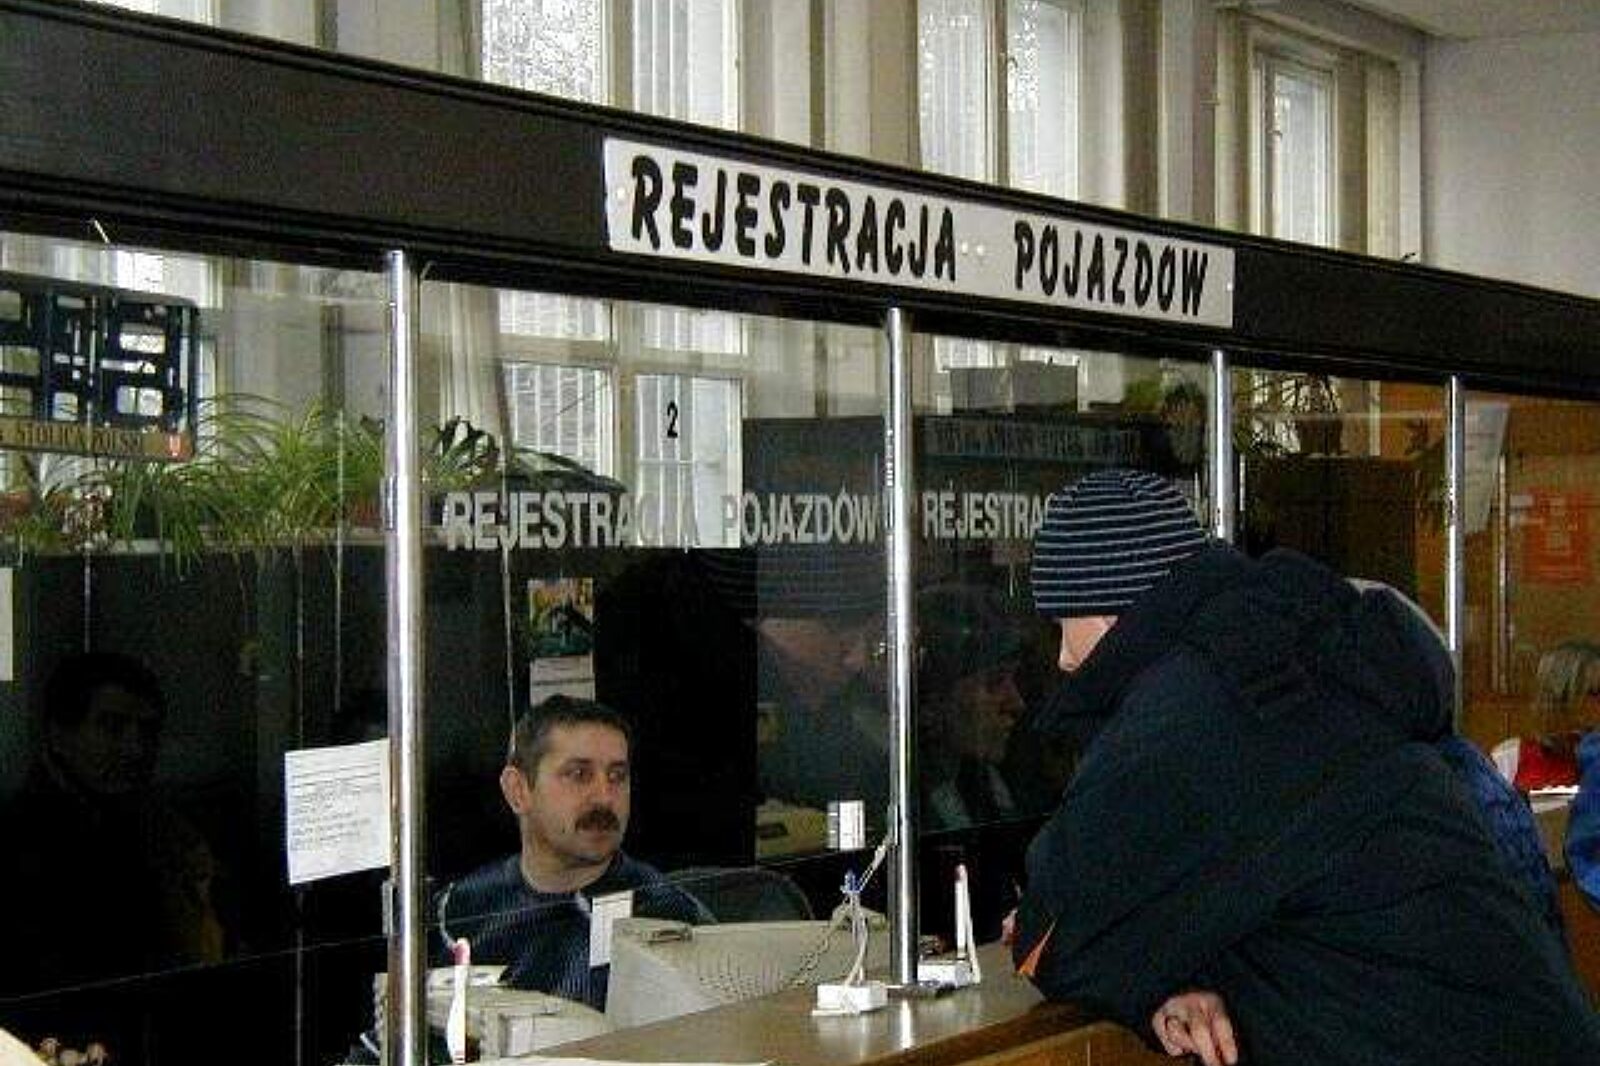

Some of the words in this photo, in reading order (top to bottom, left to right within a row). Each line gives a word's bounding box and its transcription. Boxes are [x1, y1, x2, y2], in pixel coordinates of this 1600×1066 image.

[631, 155, 956, 282] REJESTRACJA
[667, 401, 678, 438] 2
[447, 491, 700, 551] REJESTRACA
[721, 482, 879, 545] POJAZDÓW
[922, 491, 1053, 539] REJESTRA
